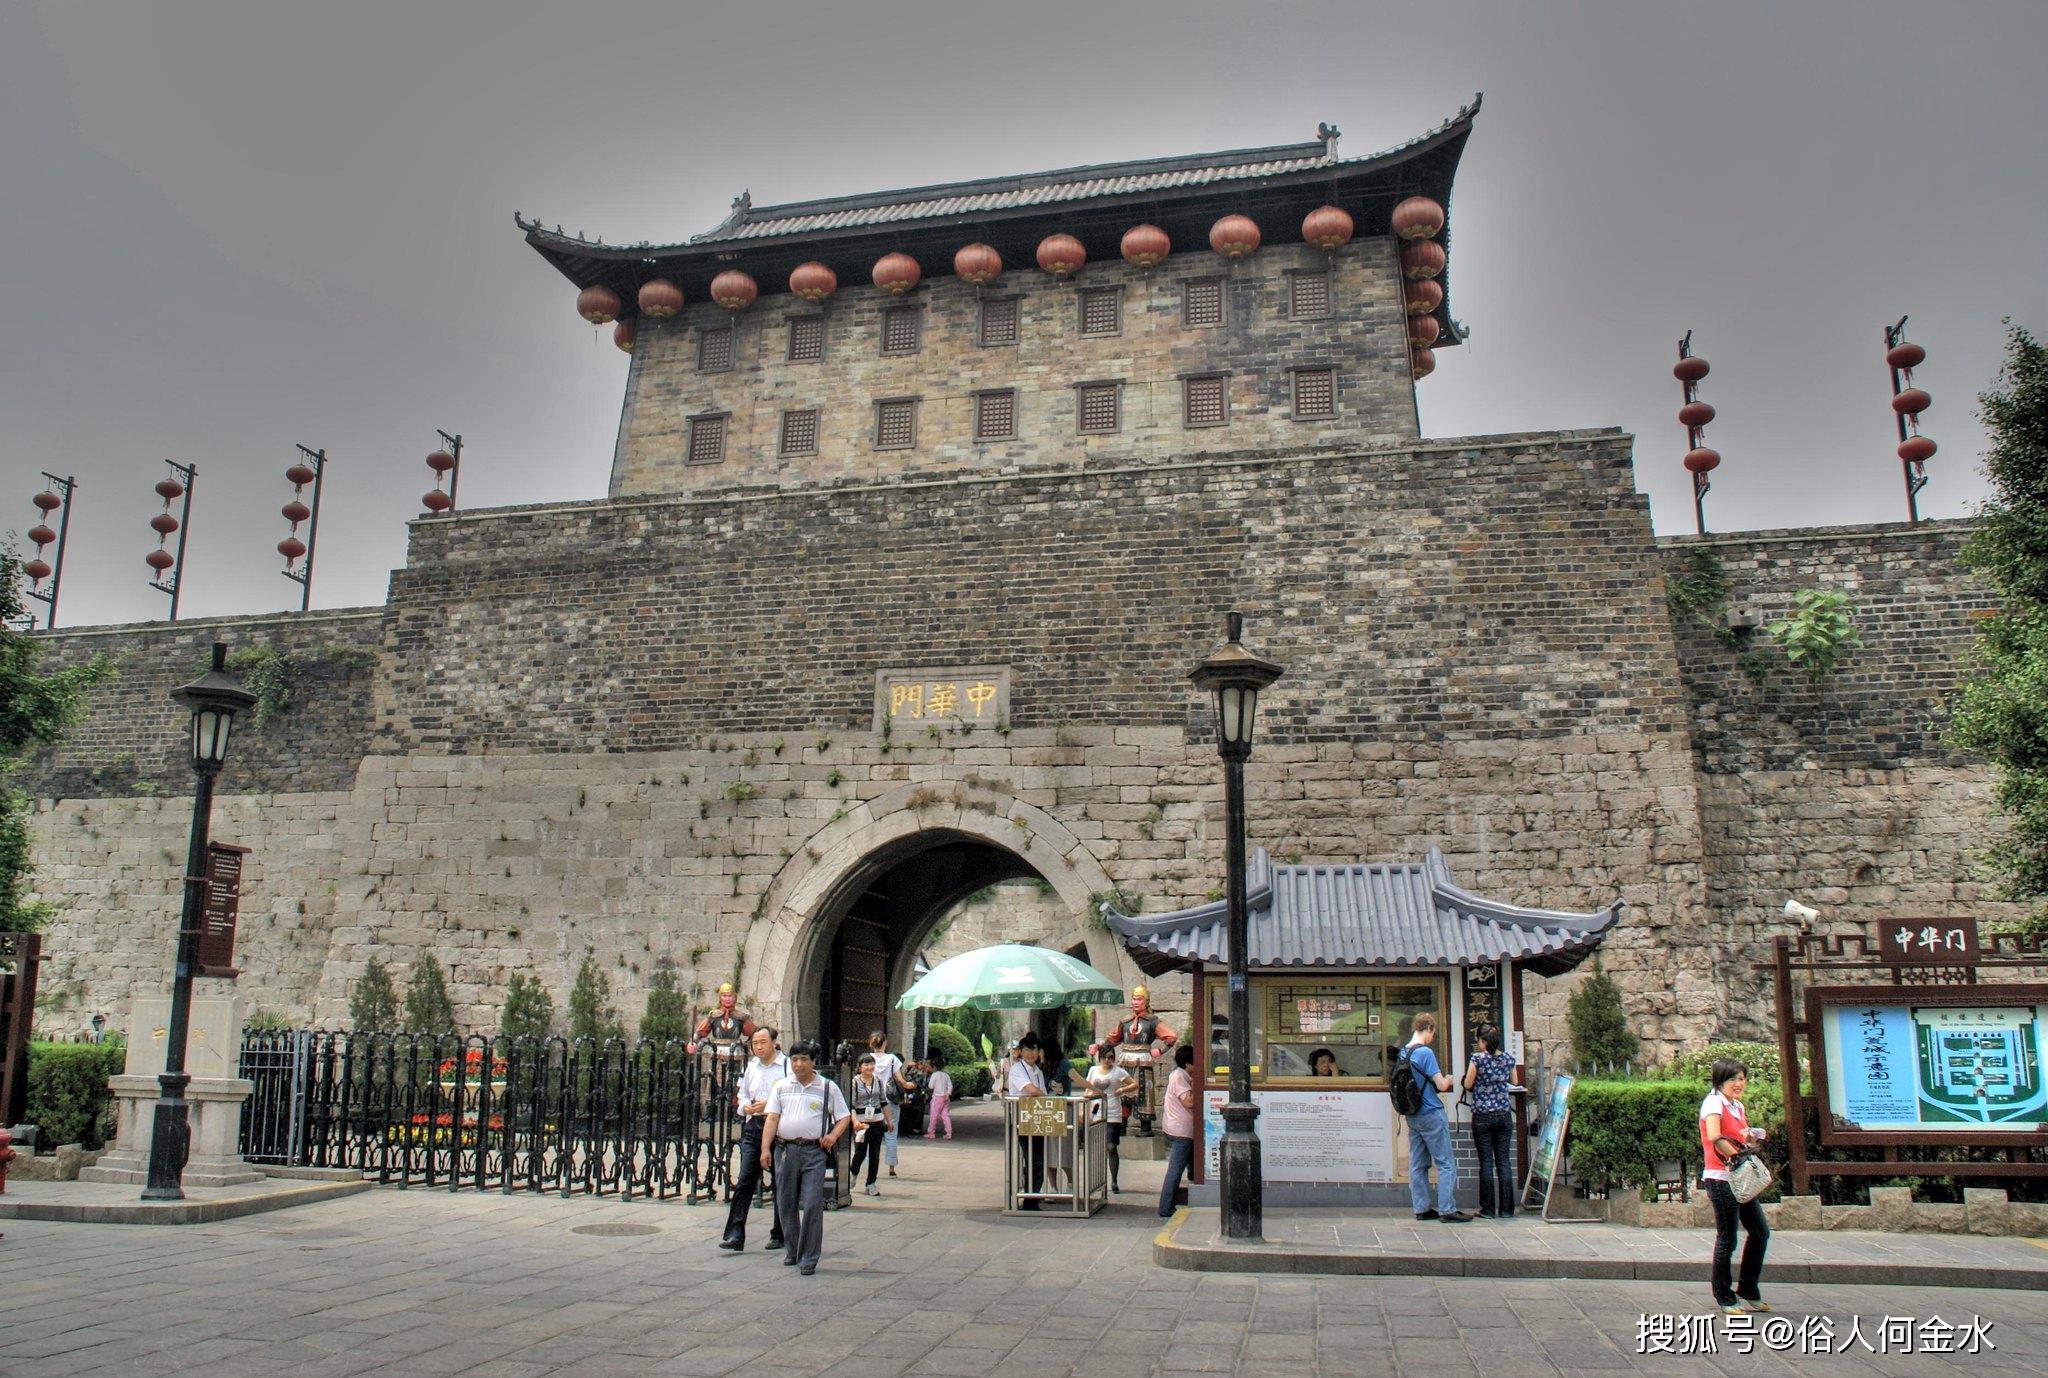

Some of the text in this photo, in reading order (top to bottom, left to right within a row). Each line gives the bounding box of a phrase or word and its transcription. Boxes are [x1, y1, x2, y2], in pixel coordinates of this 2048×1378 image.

[890, 681, 998, 719] 中華門
[1894, 926, 1967, 954] 中华门
[1033, 1099, 1053, 1109] 入口
[1033, 1125, 1053, 1134] 入口
